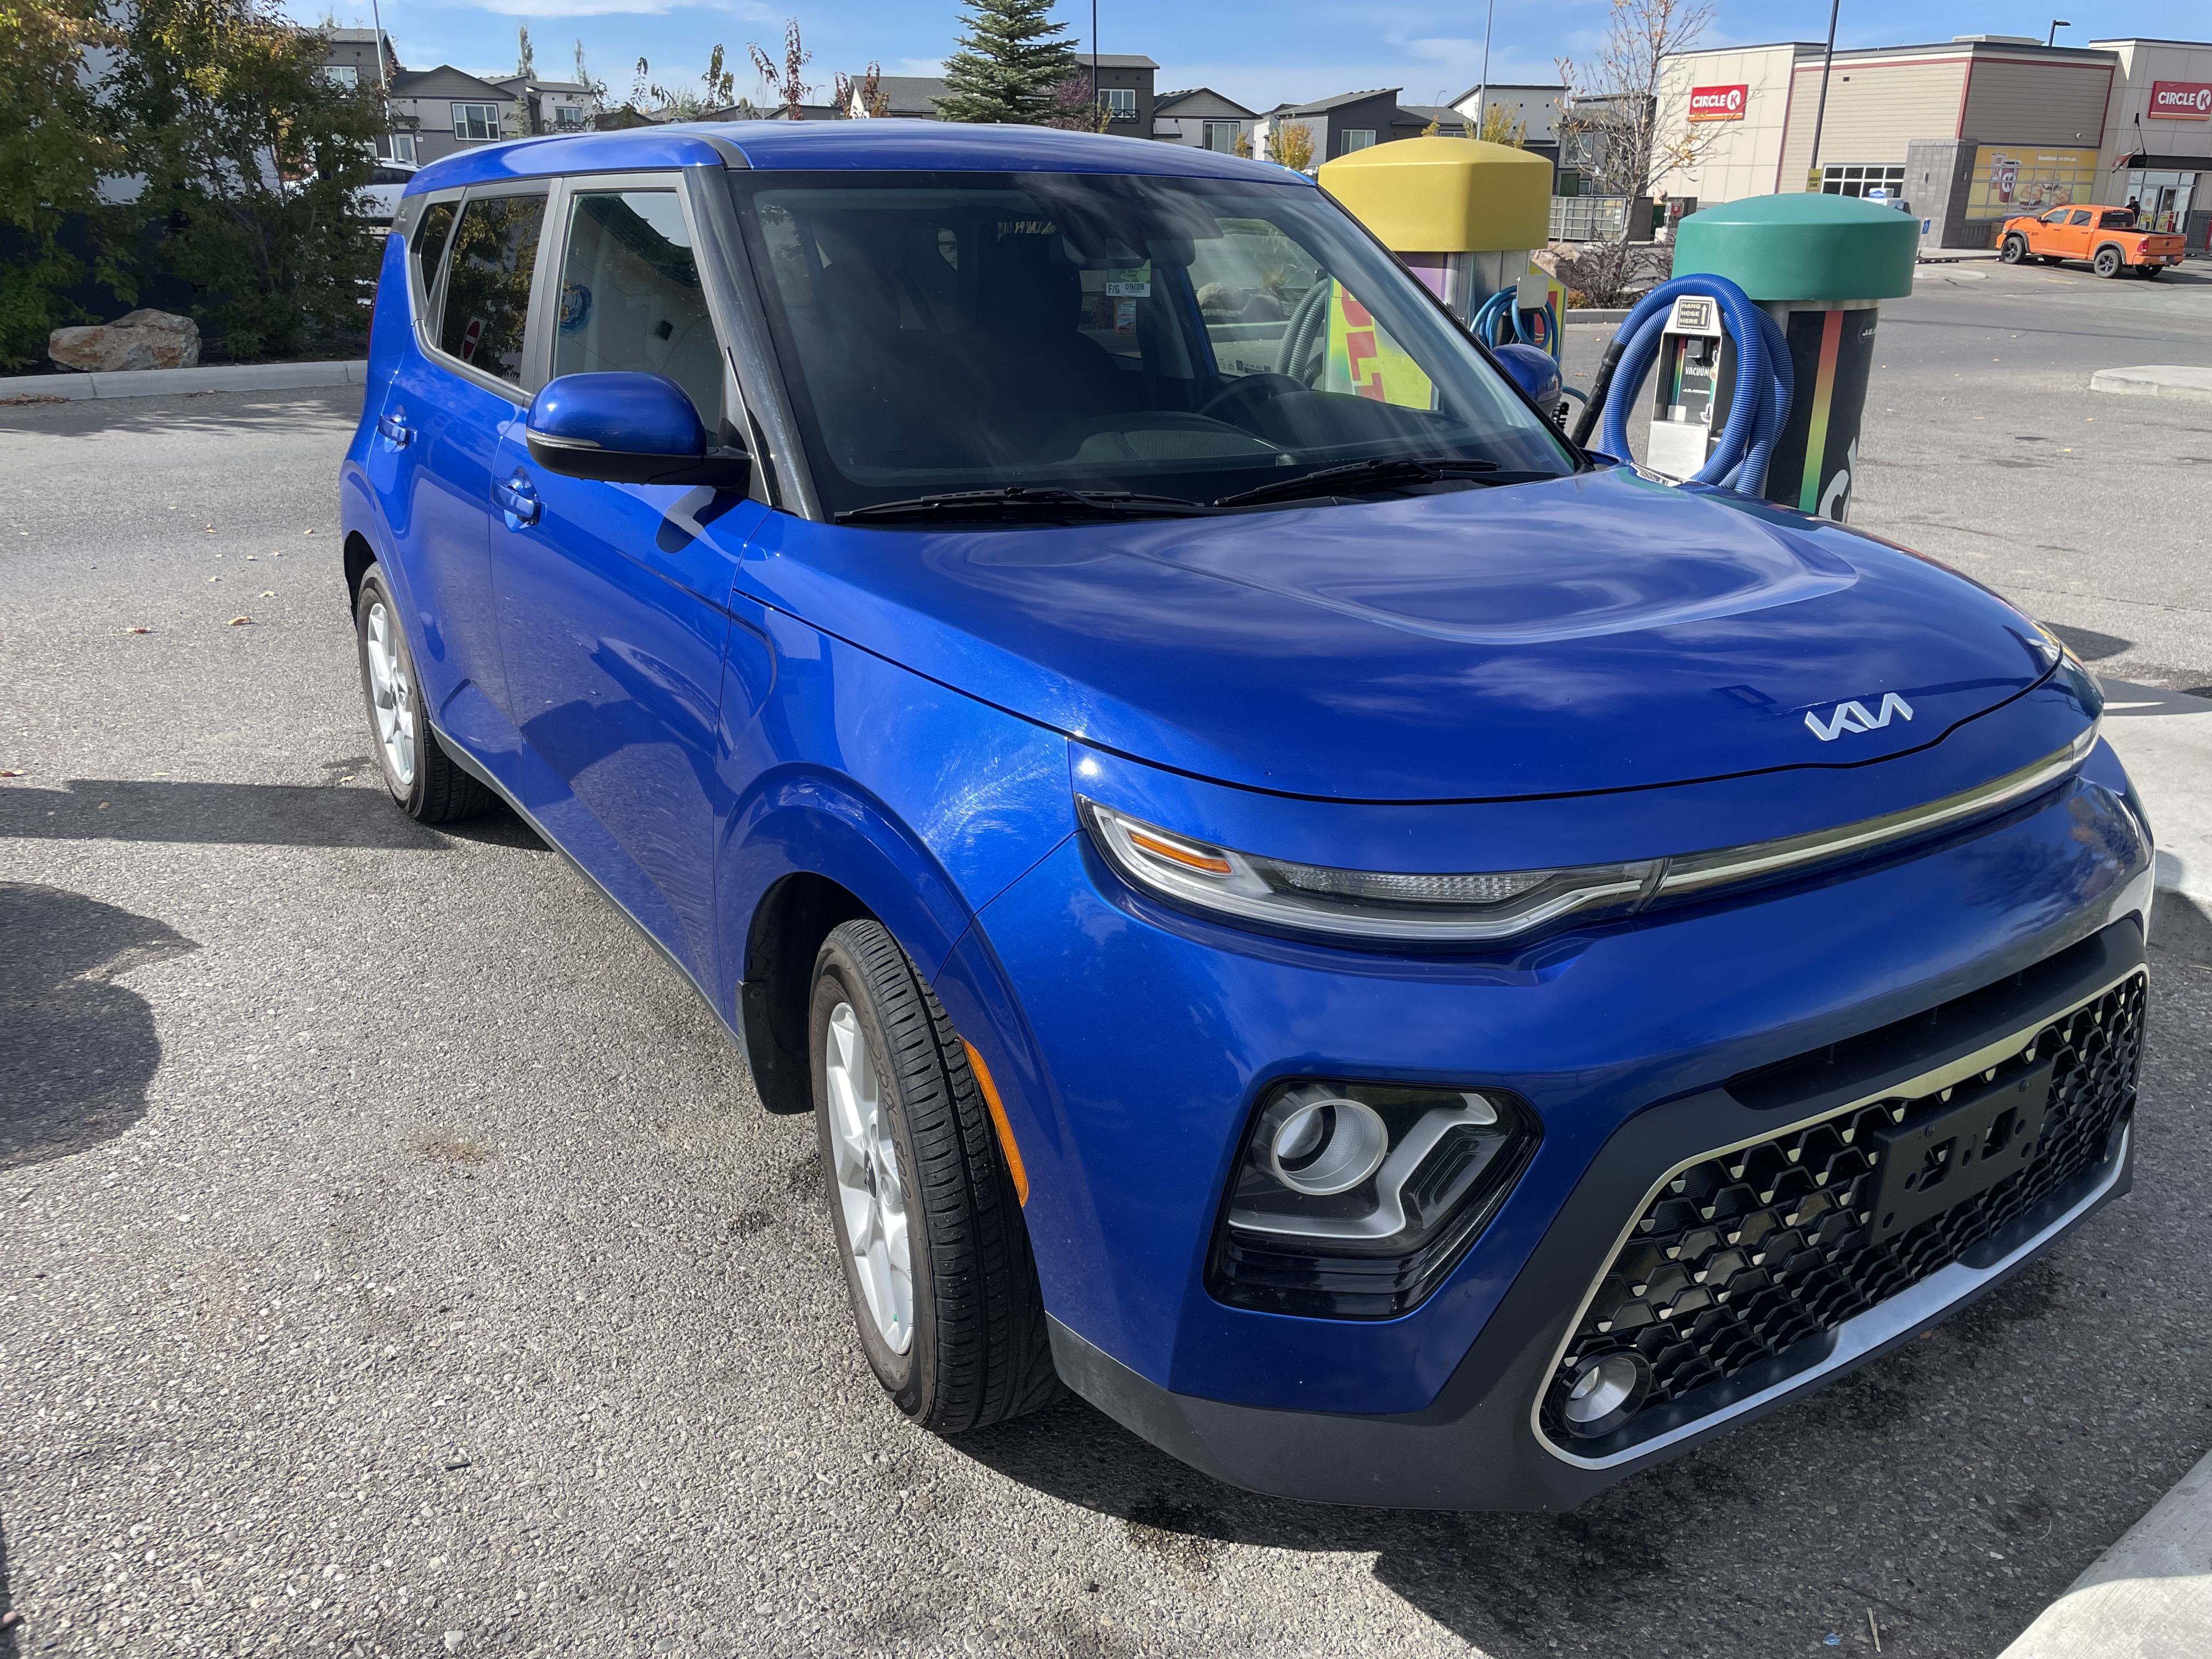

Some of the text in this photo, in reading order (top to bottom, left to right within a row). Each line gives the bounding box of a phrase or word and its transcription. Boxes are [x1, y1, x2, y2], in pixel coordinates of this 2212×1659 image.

[1692, 93, 1740, 110] CIRCLE K
[2158, 92, 2210, 110] CIRCLE K
[1108, 284, 1120, 294] F/G
[1685, 366, 1709, 377] VACUUM
[1804, 692, 1914, 742] KIA
